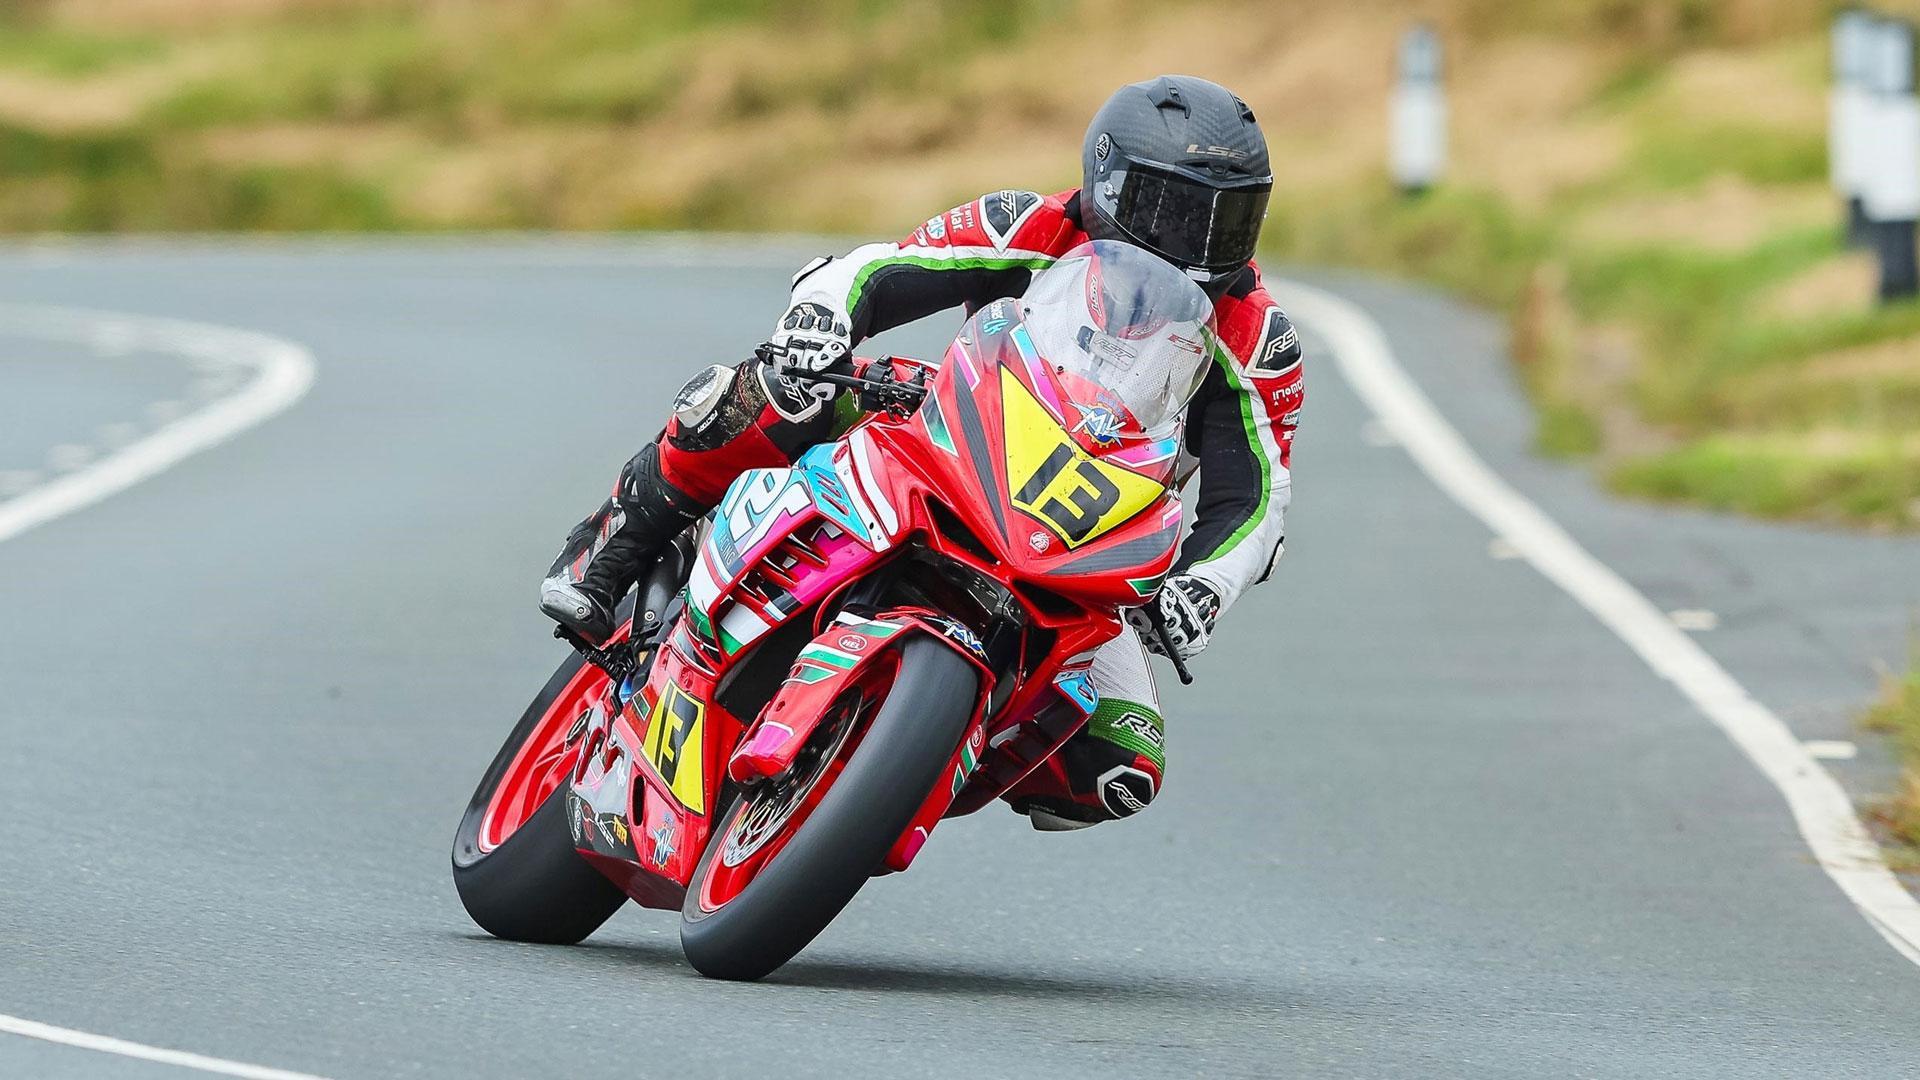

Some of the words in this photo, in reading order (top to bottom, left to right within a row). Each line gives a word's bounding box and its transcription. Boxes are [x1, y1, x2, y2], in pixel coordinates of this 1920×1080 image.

[1186, 144, 1249, 160] LS2
[1000, 190, 1018, 225] ST
[1013, 442, 1121, 542] 13
[654, 682, 699, 787] 13
